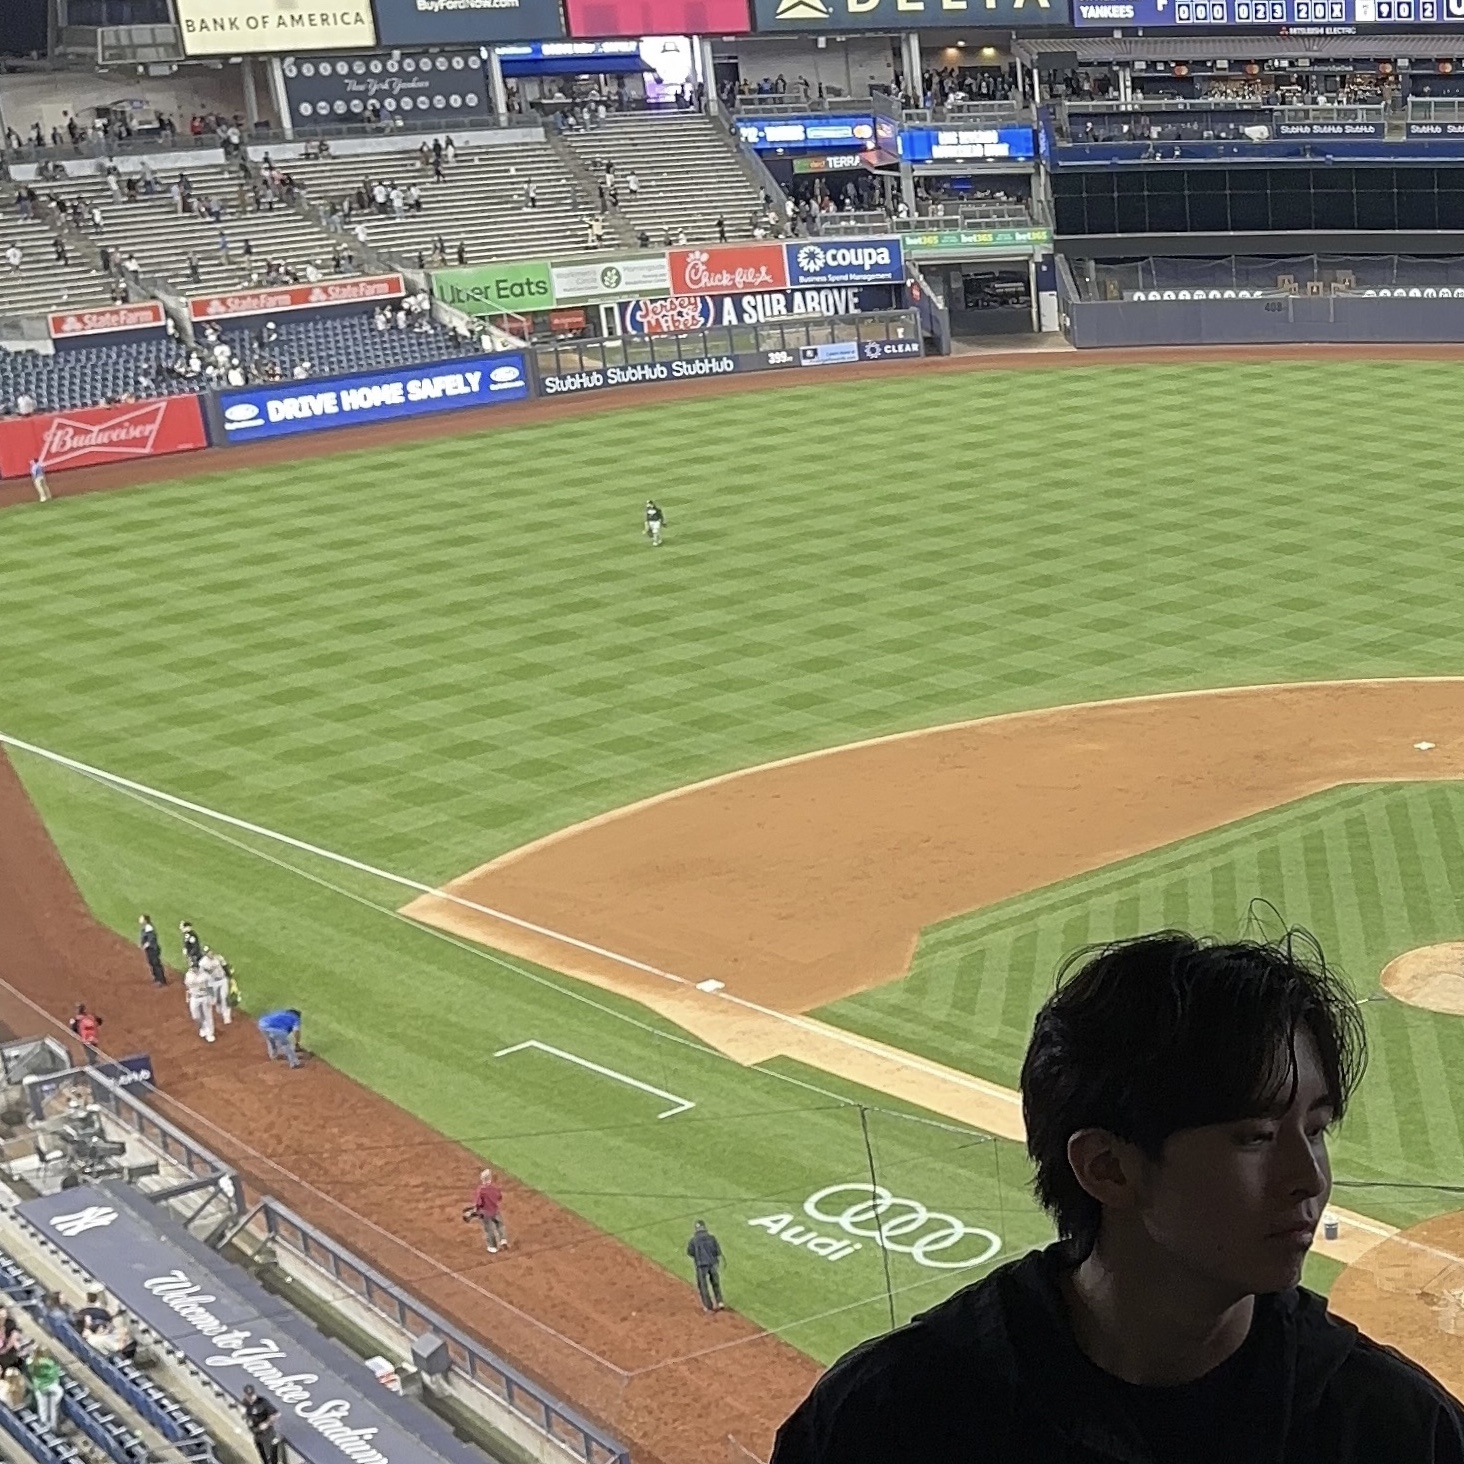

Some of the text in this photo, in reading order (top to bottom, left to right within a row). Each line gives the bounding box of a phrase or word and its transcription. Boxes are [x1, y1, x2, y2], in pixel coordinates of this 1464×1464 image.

[185, 11, 366, 33] BANK OF AMERICA
[1079, 5, 1134, 19] YANKEES
[905, 235, 939, 245] bet365
[960, 232, 993, 242] bet365
[1015, 230, 1048, 241] bet365
[825, 246, 891, 270] coupa
[685, 259, 773, 289] Chick-fil-A
[799, 271, 893, 285] Business Spend Management
[494, 277, 549, 300] Eats
[638, 295, 701, 320] Jersey
[721, 296, 739, 327] A
[883, 343, 919, 355] CLEAR
[545, 357, 734, 393] StubHub StubHub StubHub
[266, 371, 482, 423] DRIVE HOME SAFELY
[50, 422, 159, 454] Budweiser
[747, 1212, 863, 1261] Audi
[143, 1269, 228, 1336] Welcome
[212, 1329, 252, 1350] to
[205, 1338, 319, 1404] Yankee
